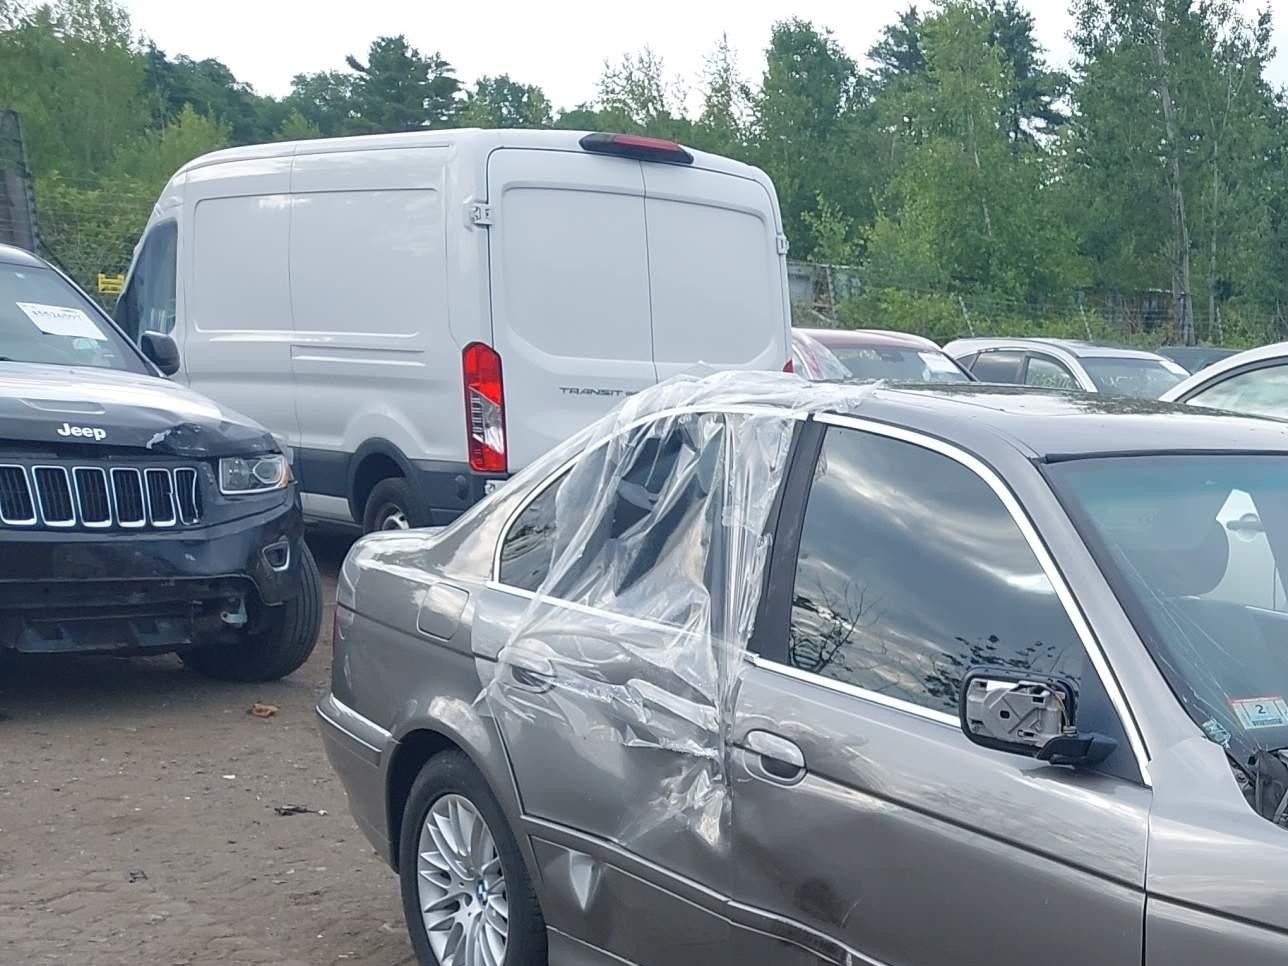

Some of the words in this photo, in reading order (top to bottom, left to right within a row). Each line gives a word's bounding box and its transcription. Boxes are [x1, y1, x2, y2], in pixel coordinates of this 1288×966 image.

[559, 386, 624, 396] TRANSIT
[56, 422, 107, 441] Jeep
[1255, 704, 1266, 715] 2
